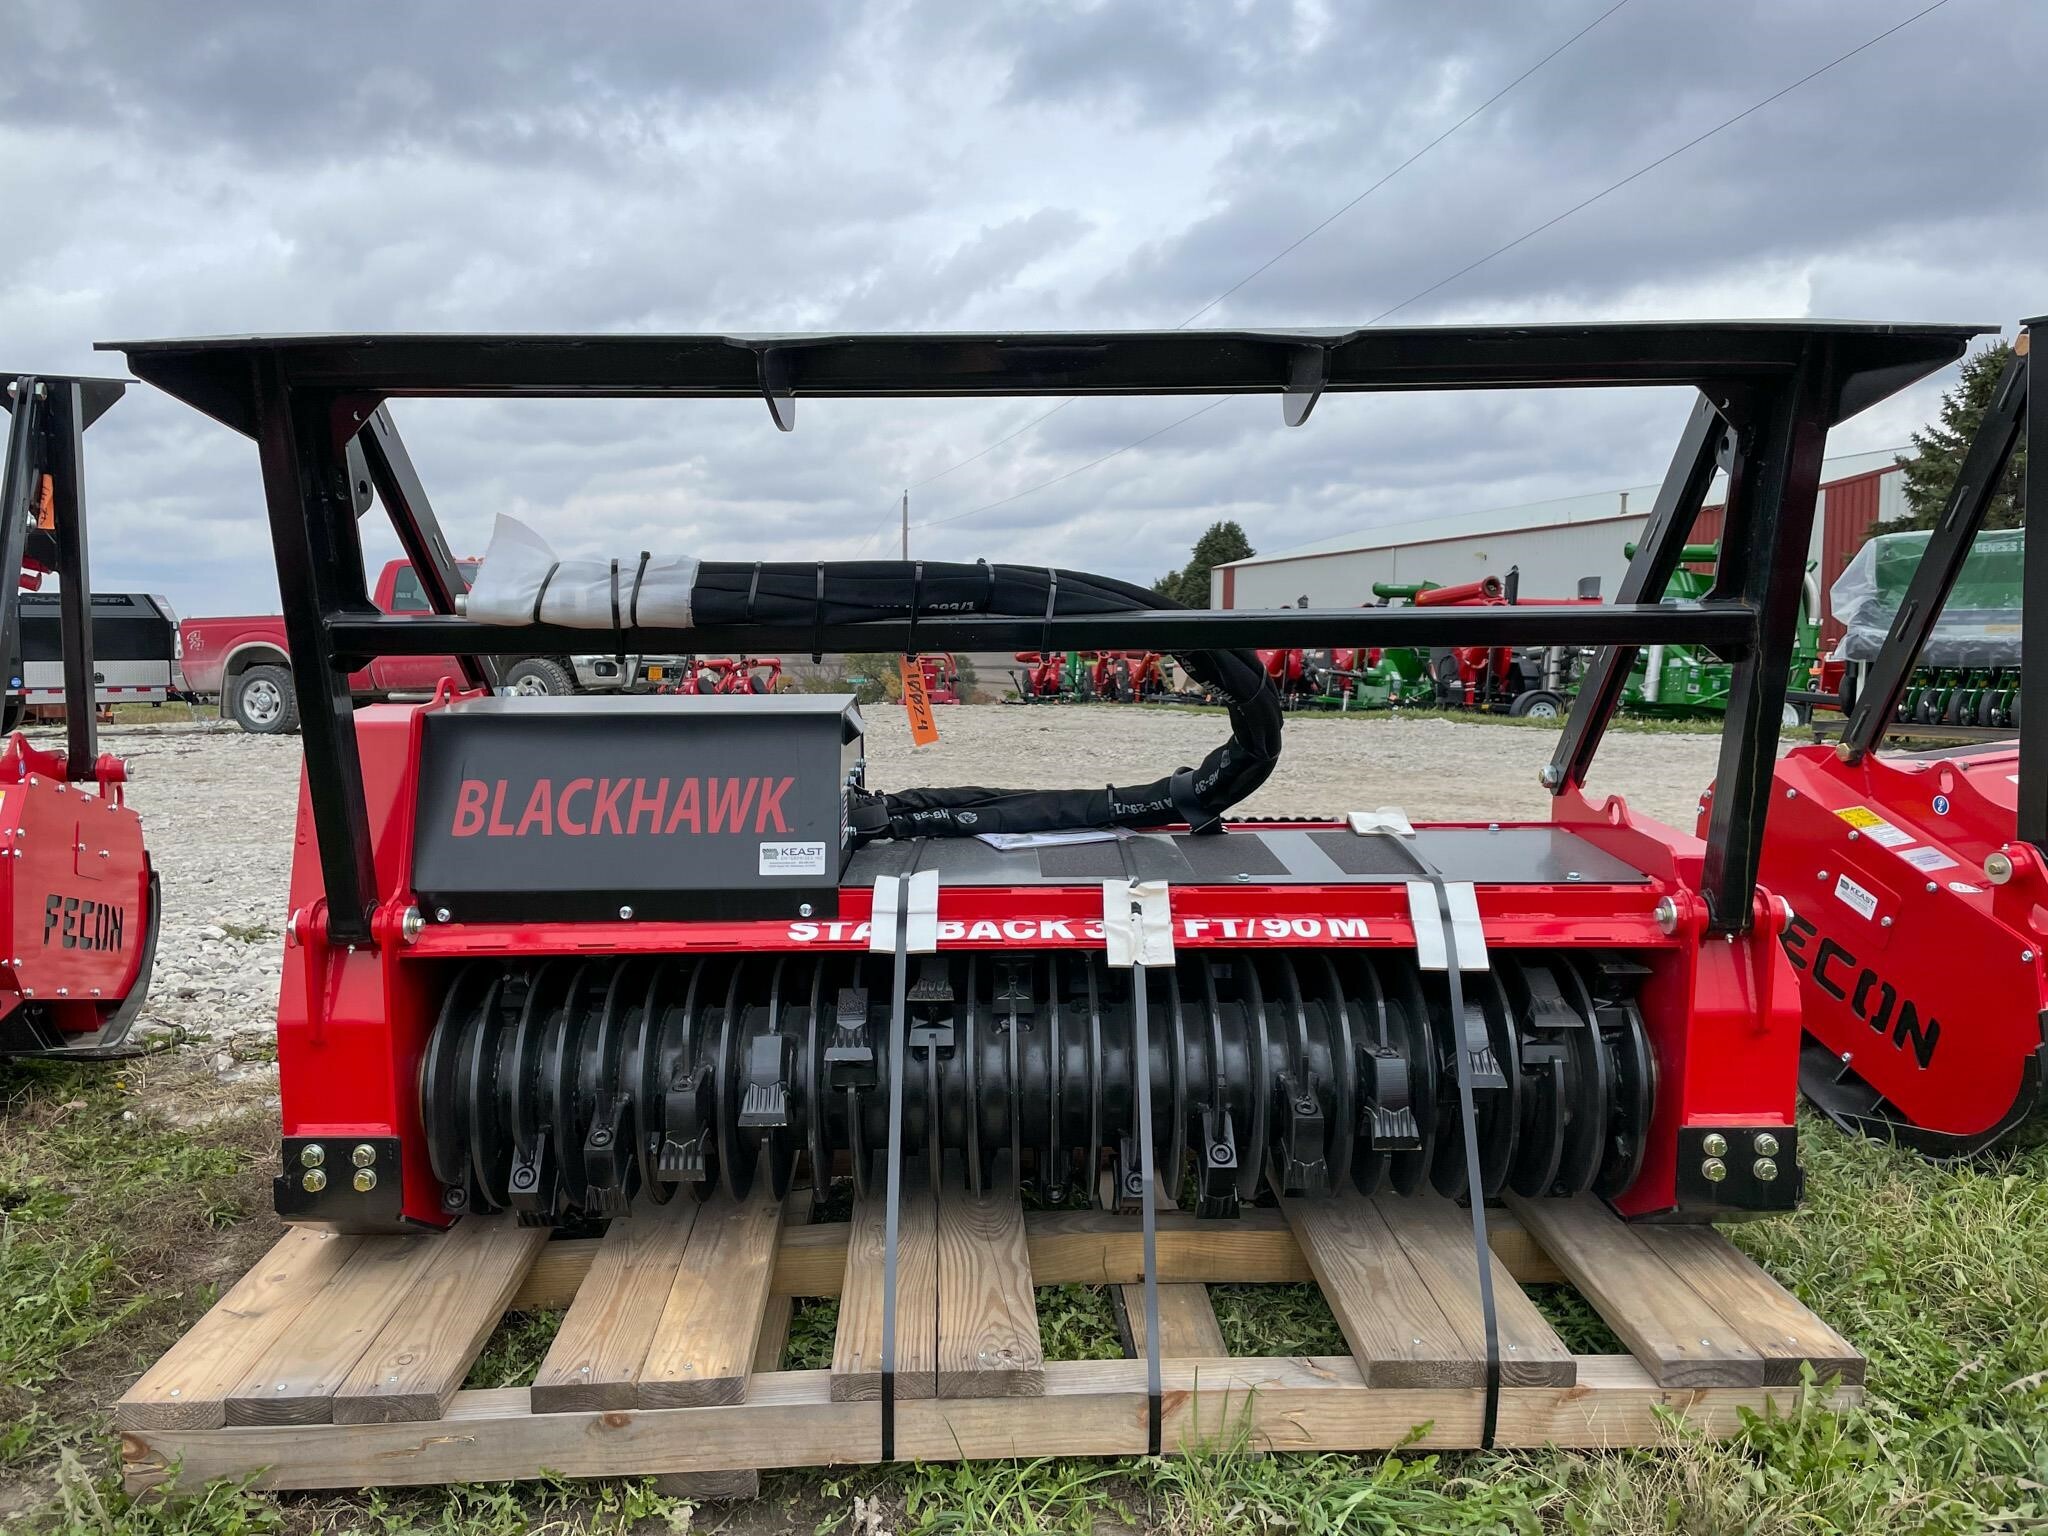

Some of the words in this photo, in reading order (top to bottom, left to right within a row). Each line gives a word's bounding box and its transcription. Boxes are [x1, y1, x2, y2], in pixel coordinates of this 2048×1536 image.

[452, 776, 795, 837] BLACKHAWK
[781, 848, 823, 856] KEAST
[1850, 883, 1875, 907] KEAST
[44, 894, 123, 953] FECON
[788, 921, 870, 941] STA
[937, 920, 1073, 940] BACK
[1780, 911, 1940, 1070] ECON
